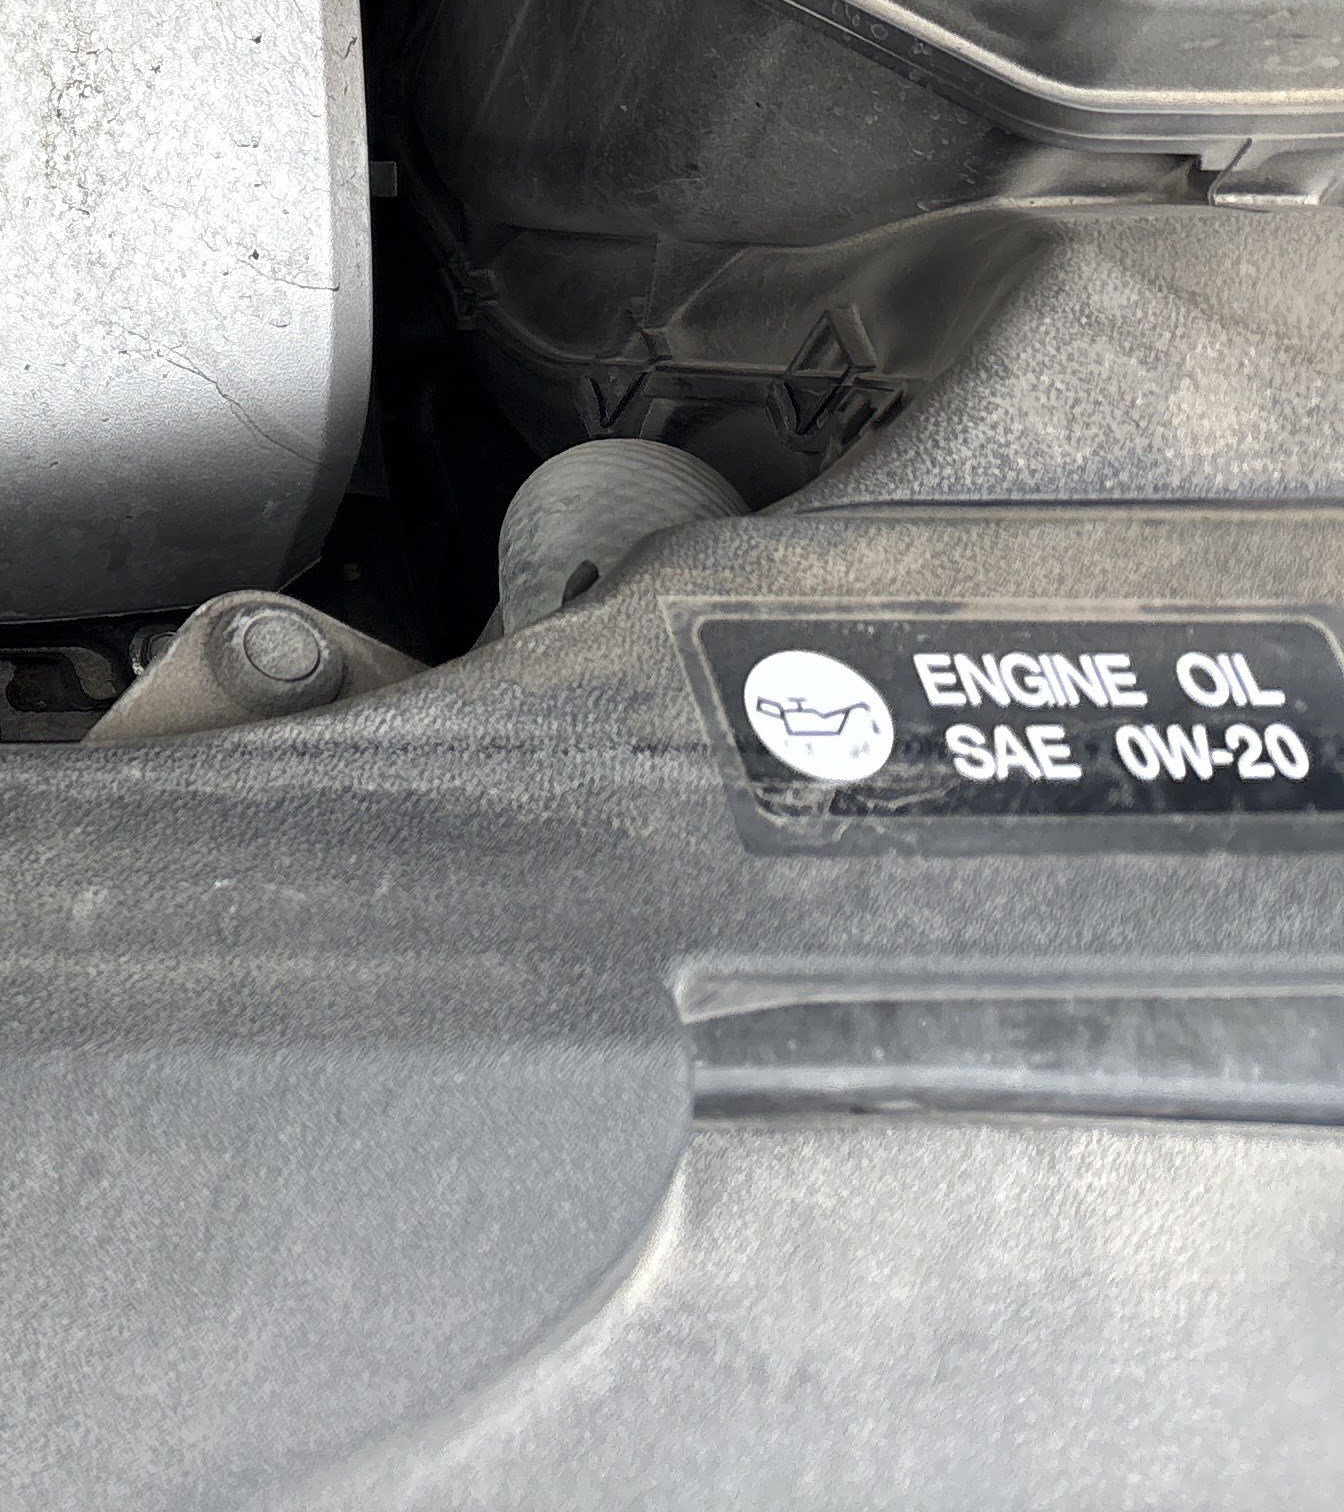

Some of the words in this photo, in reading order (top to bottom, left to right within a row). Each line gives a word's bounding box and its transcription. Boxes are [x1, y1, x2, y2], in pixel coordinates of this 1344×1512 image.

[912, 652, 1149, 709] ENGINE
[1175, 651, 1286, 709] OIL
[944, 723, 1083, 781] SAE
[1114, 723, 1311, 781] 0W-20
